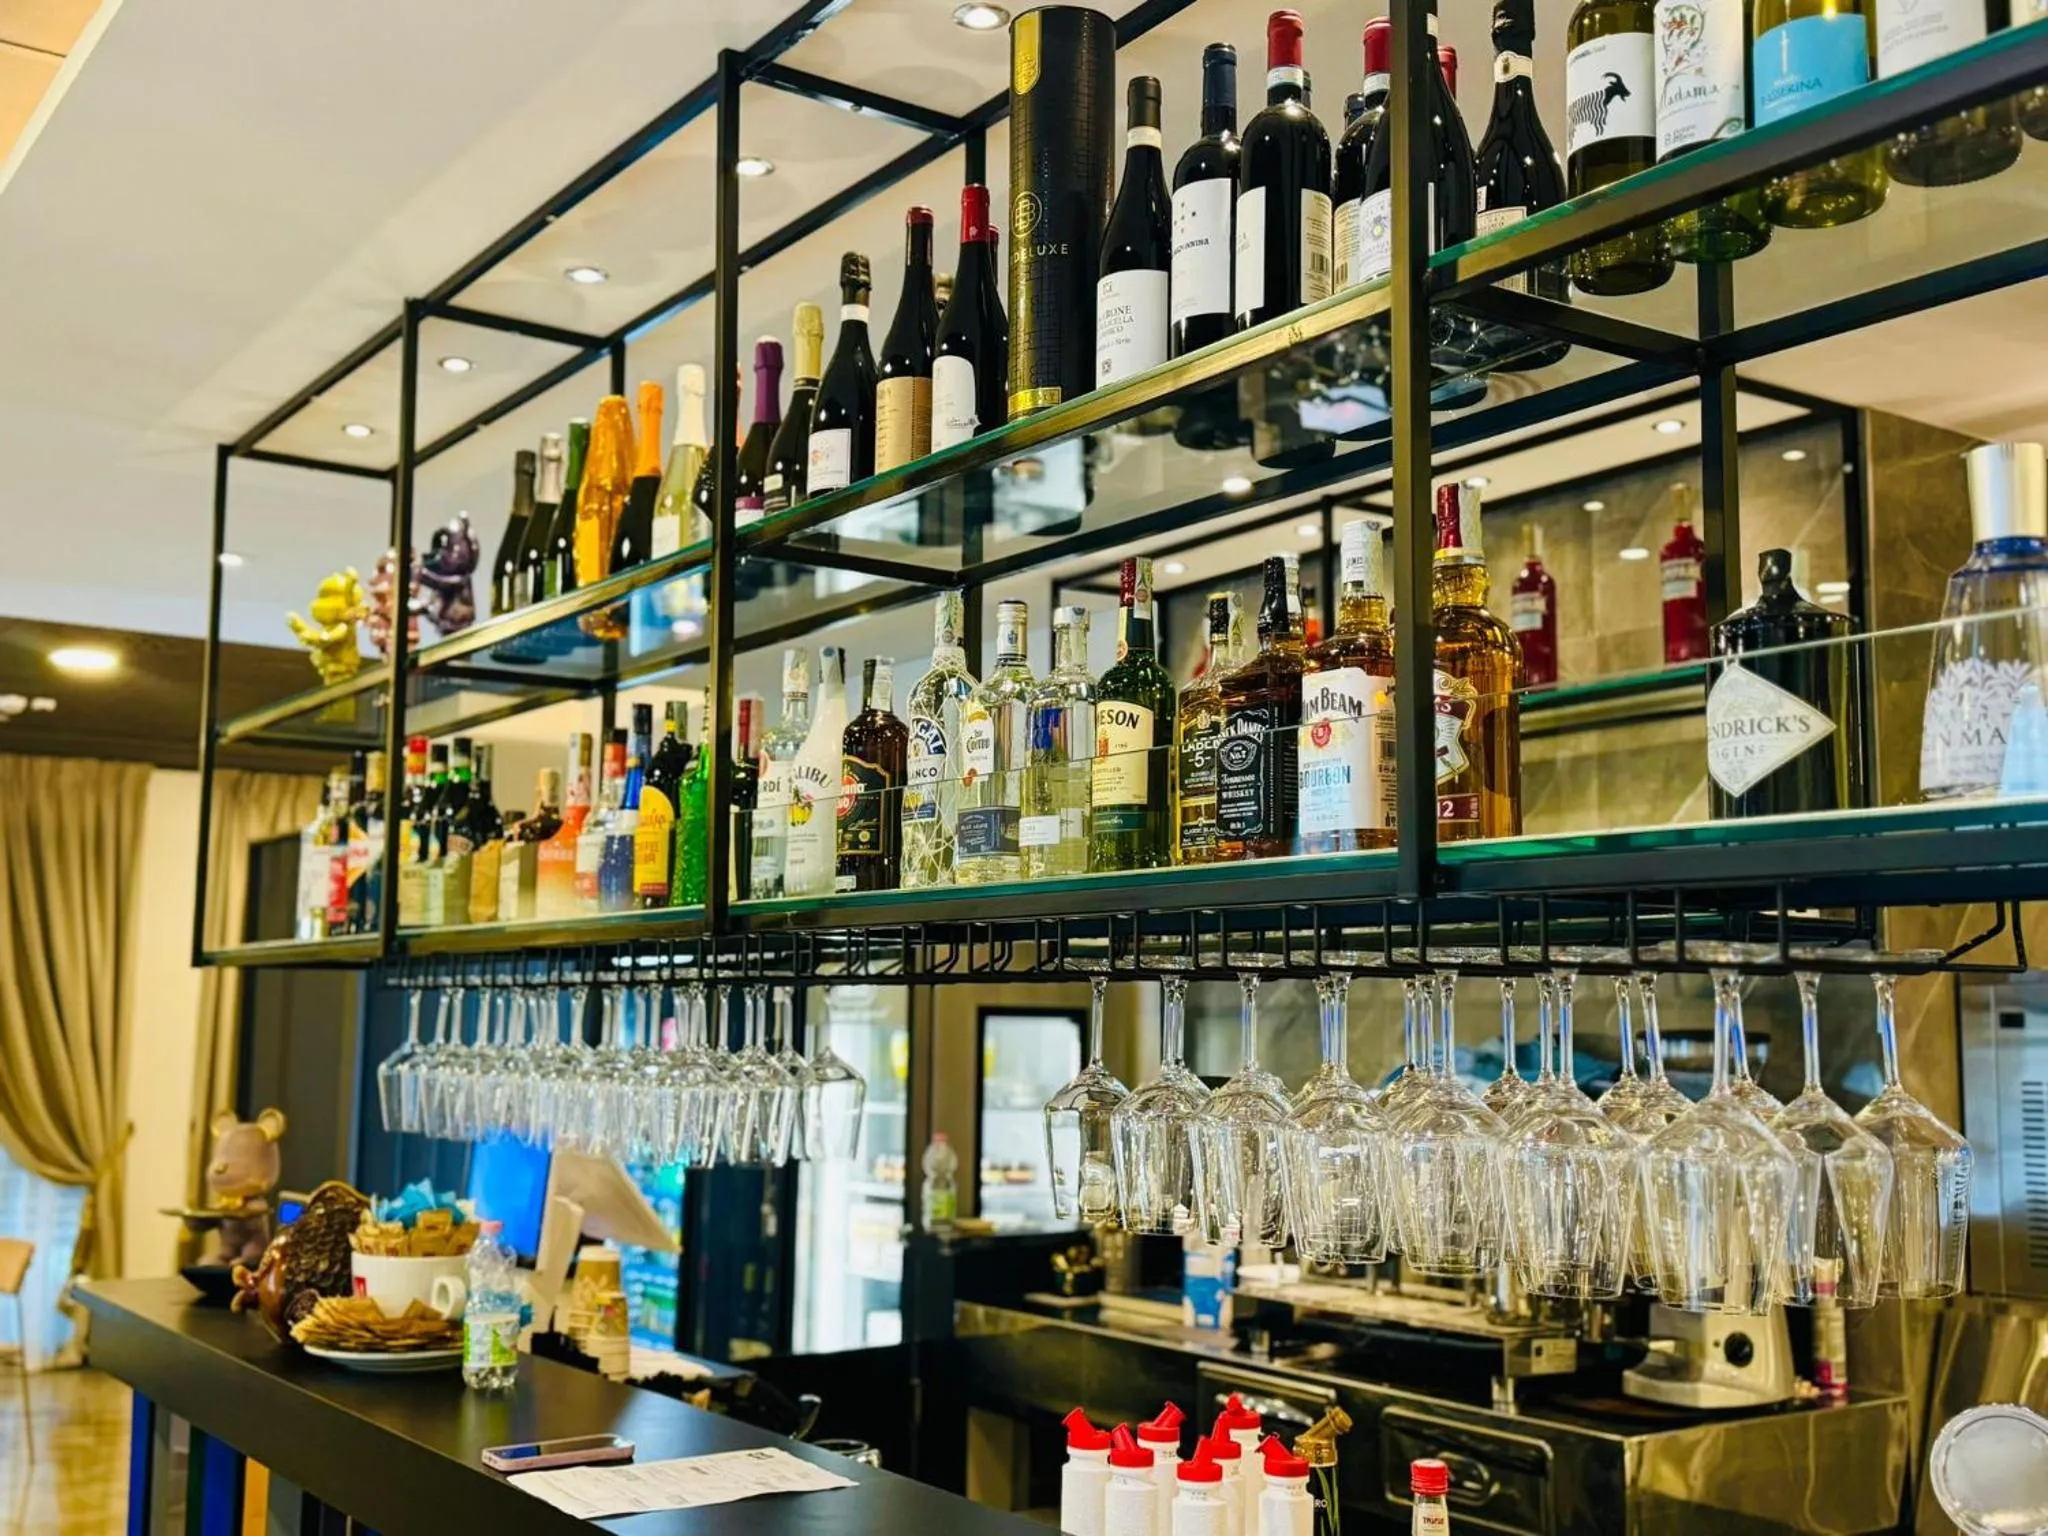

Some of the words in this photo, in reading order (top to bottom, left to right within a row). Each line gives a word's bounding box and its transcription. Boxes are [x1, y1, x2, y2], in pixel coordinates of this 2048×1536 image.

[1013, 243, 1069, 263] DELUXE
[1320, 686, 1363, 722] BEAM
[1099, 709, 1140, 729] ESON
[763, 776, 781, 793] RDÍ
